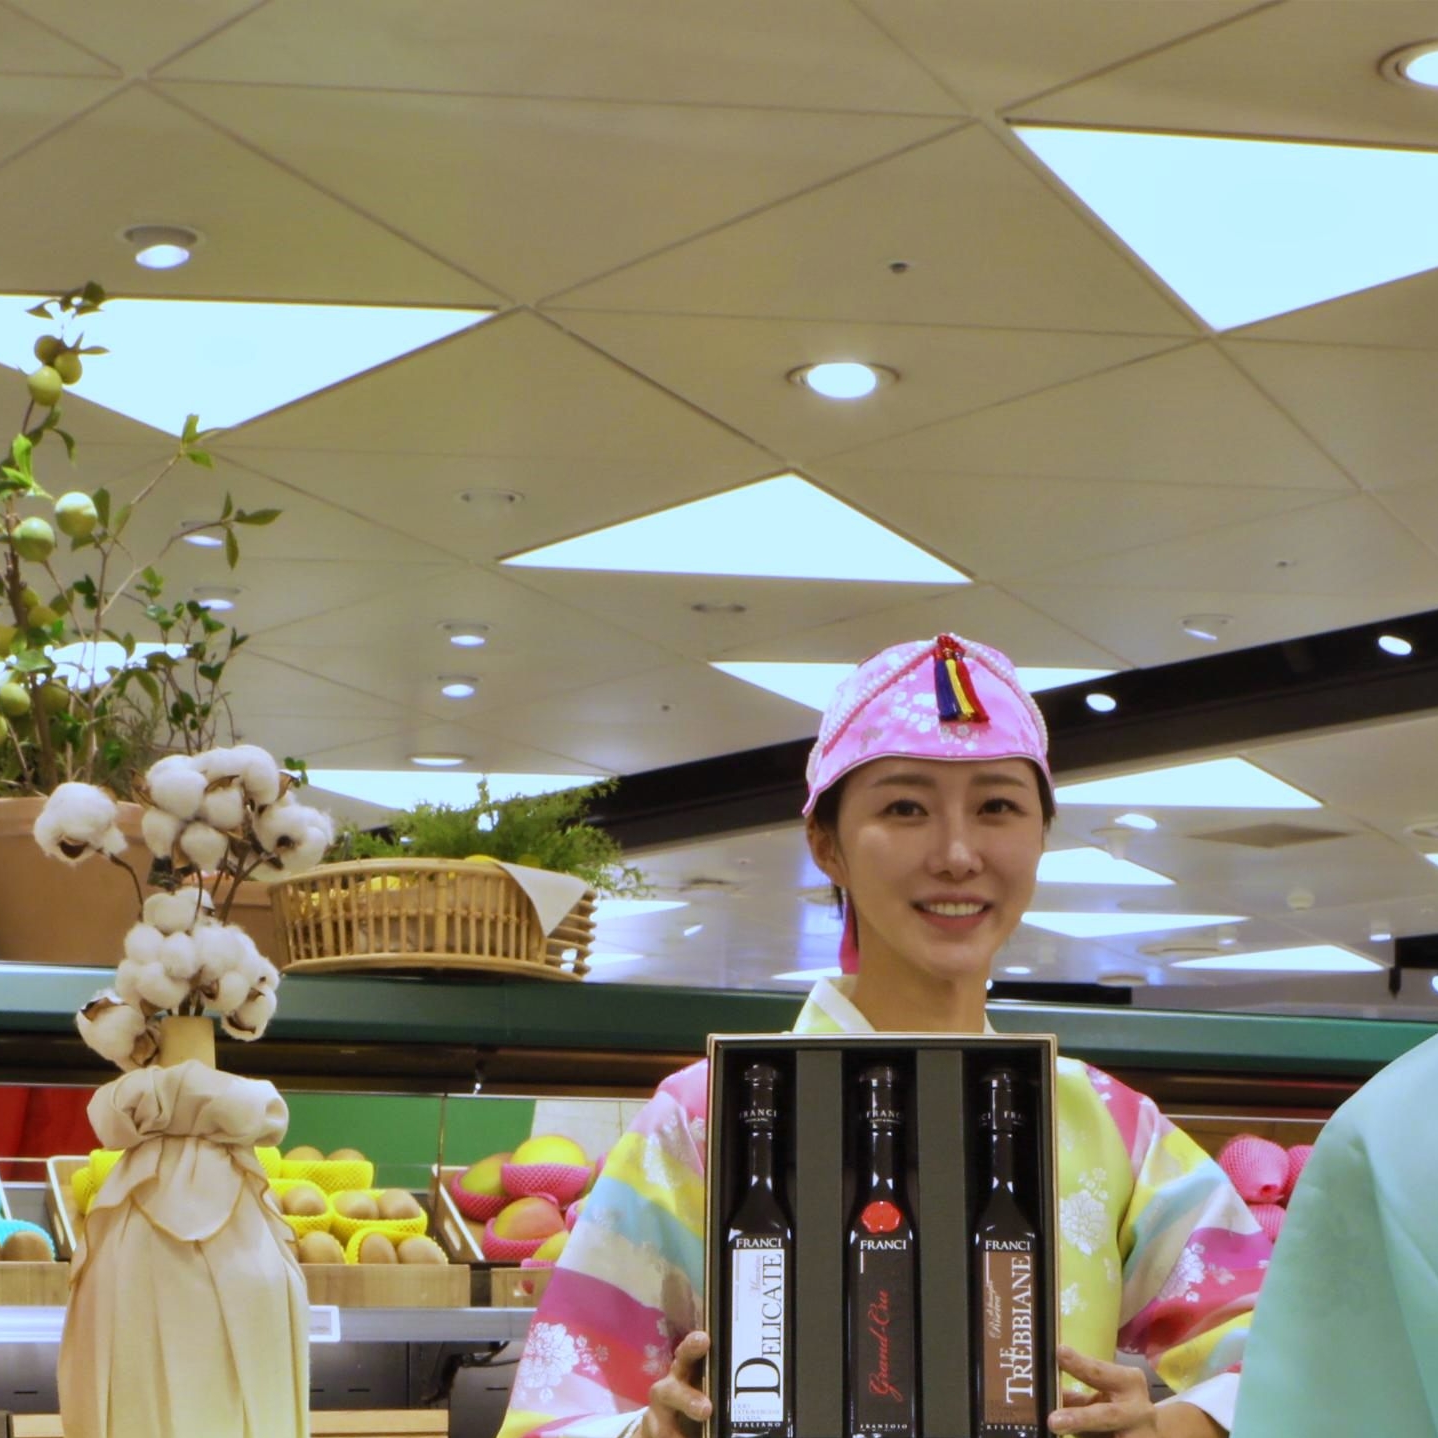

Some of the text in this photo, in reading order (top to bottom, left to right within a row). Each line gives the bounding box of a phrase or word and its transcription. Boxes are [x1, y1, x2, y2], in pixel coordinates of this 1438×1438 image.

[736, 1238, 782, 1249] FRANCI
[860, 1240, 907, 1250] FRANCI
[985, 1240, 1031, 1251] FRANCI
[734, 1253, 783, 1399] DELICATE
[1006, 1255, 1034, 1404] TREBBIANE
